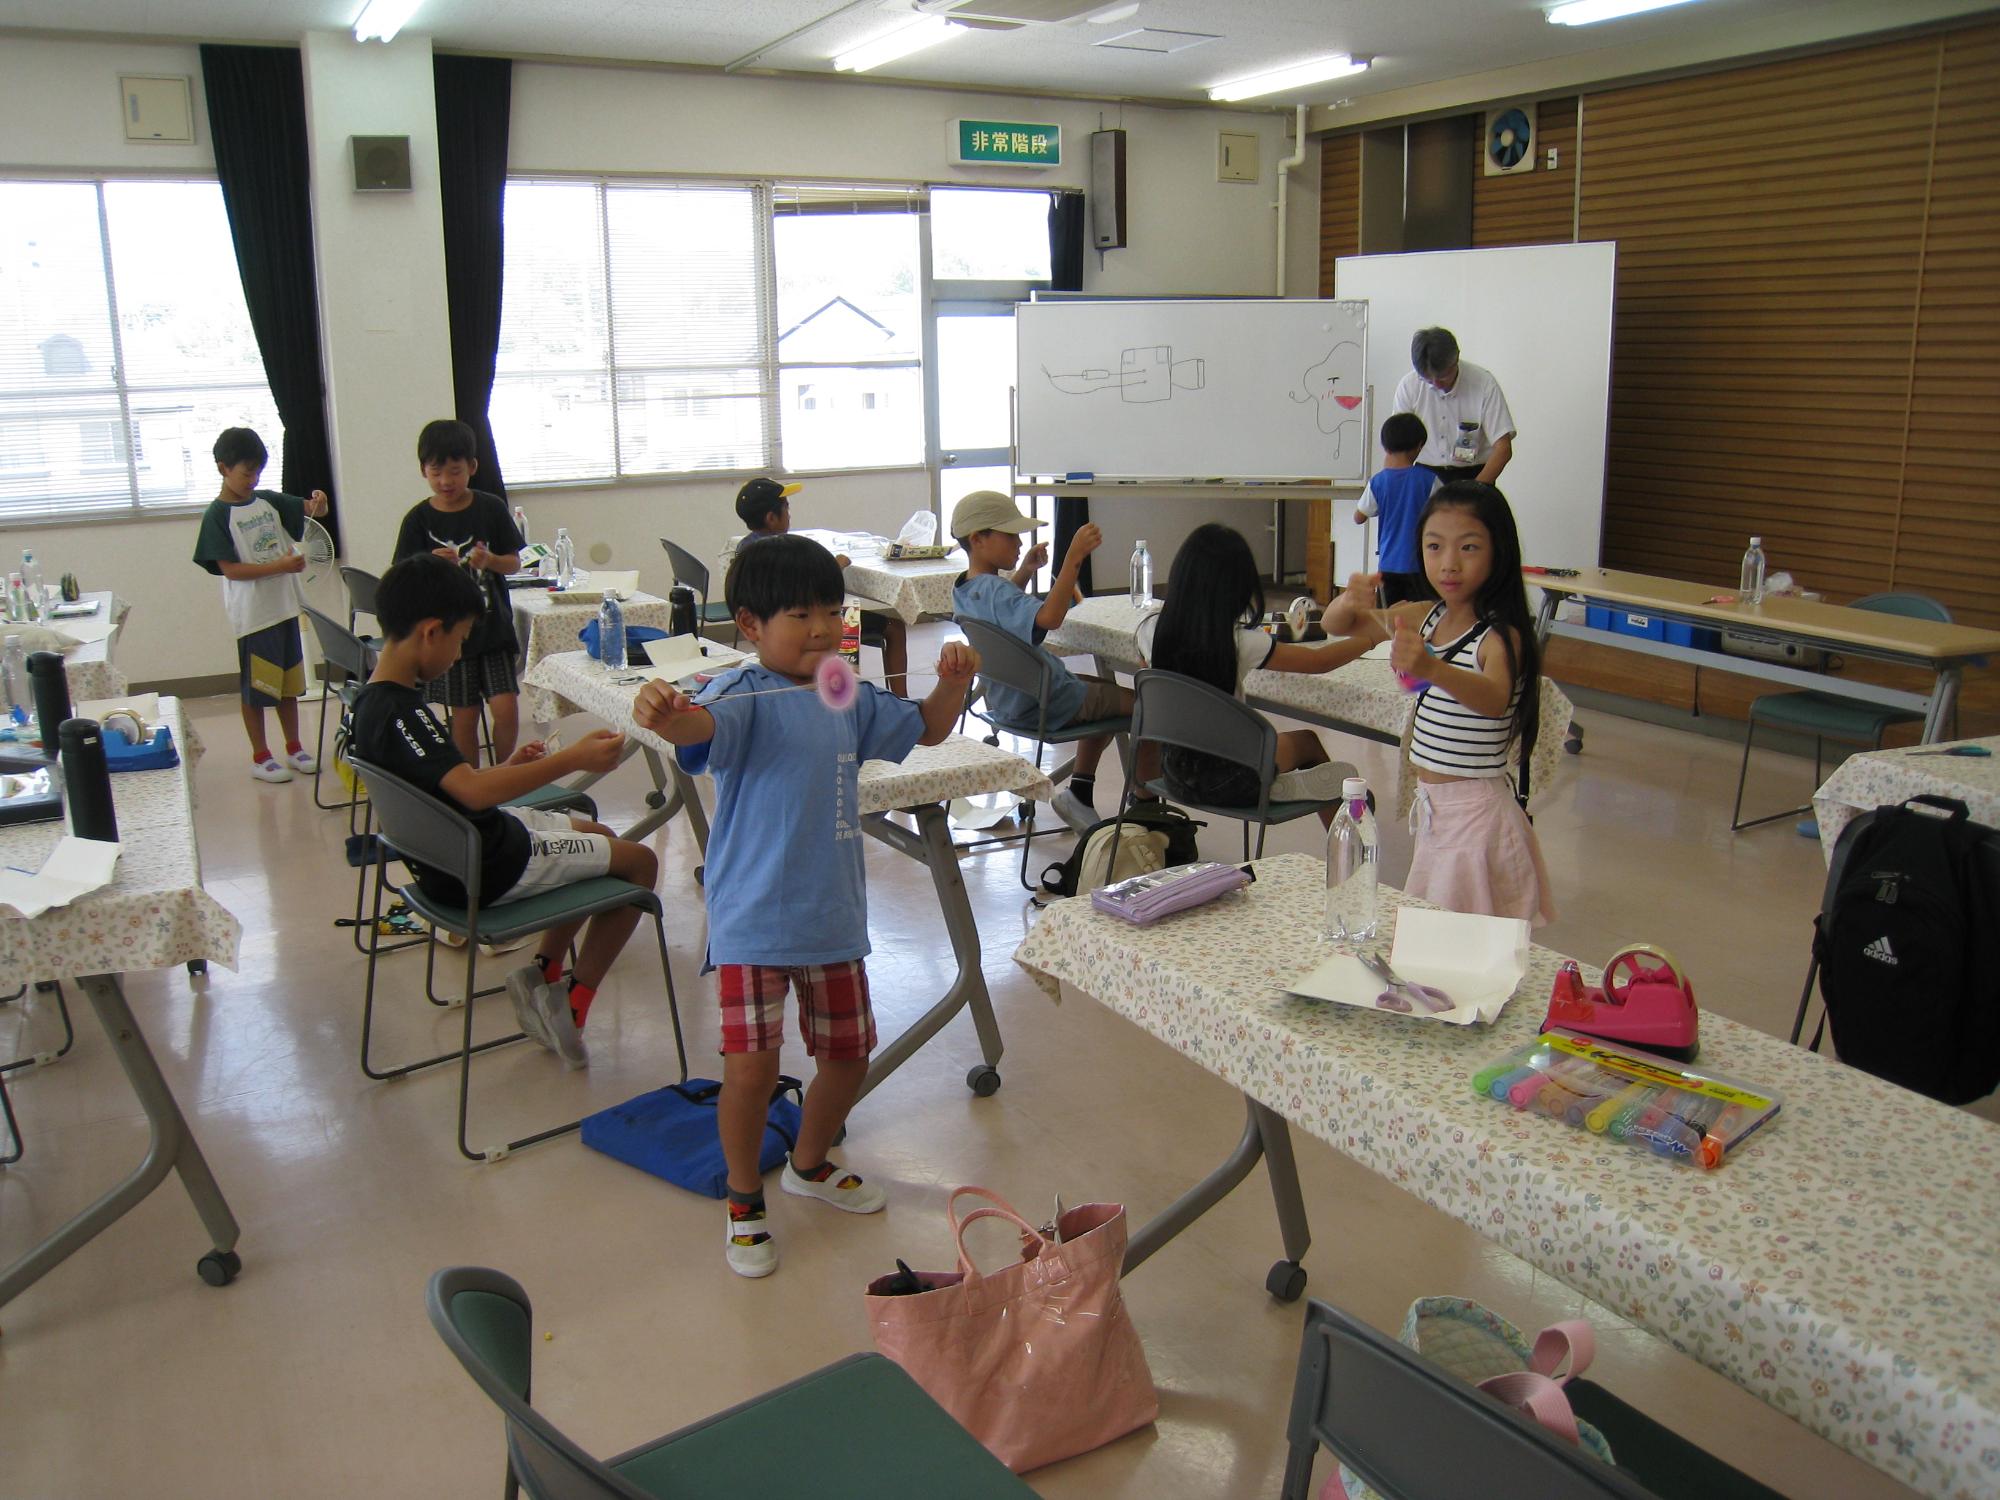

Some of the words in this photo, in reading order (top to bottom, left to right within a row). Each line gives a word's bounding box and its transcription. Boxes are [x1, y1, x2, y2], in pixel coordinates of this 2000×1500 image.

[971, 131, 1048, 154] 非常階段
[1863, 947, 1898, 965] adidas
